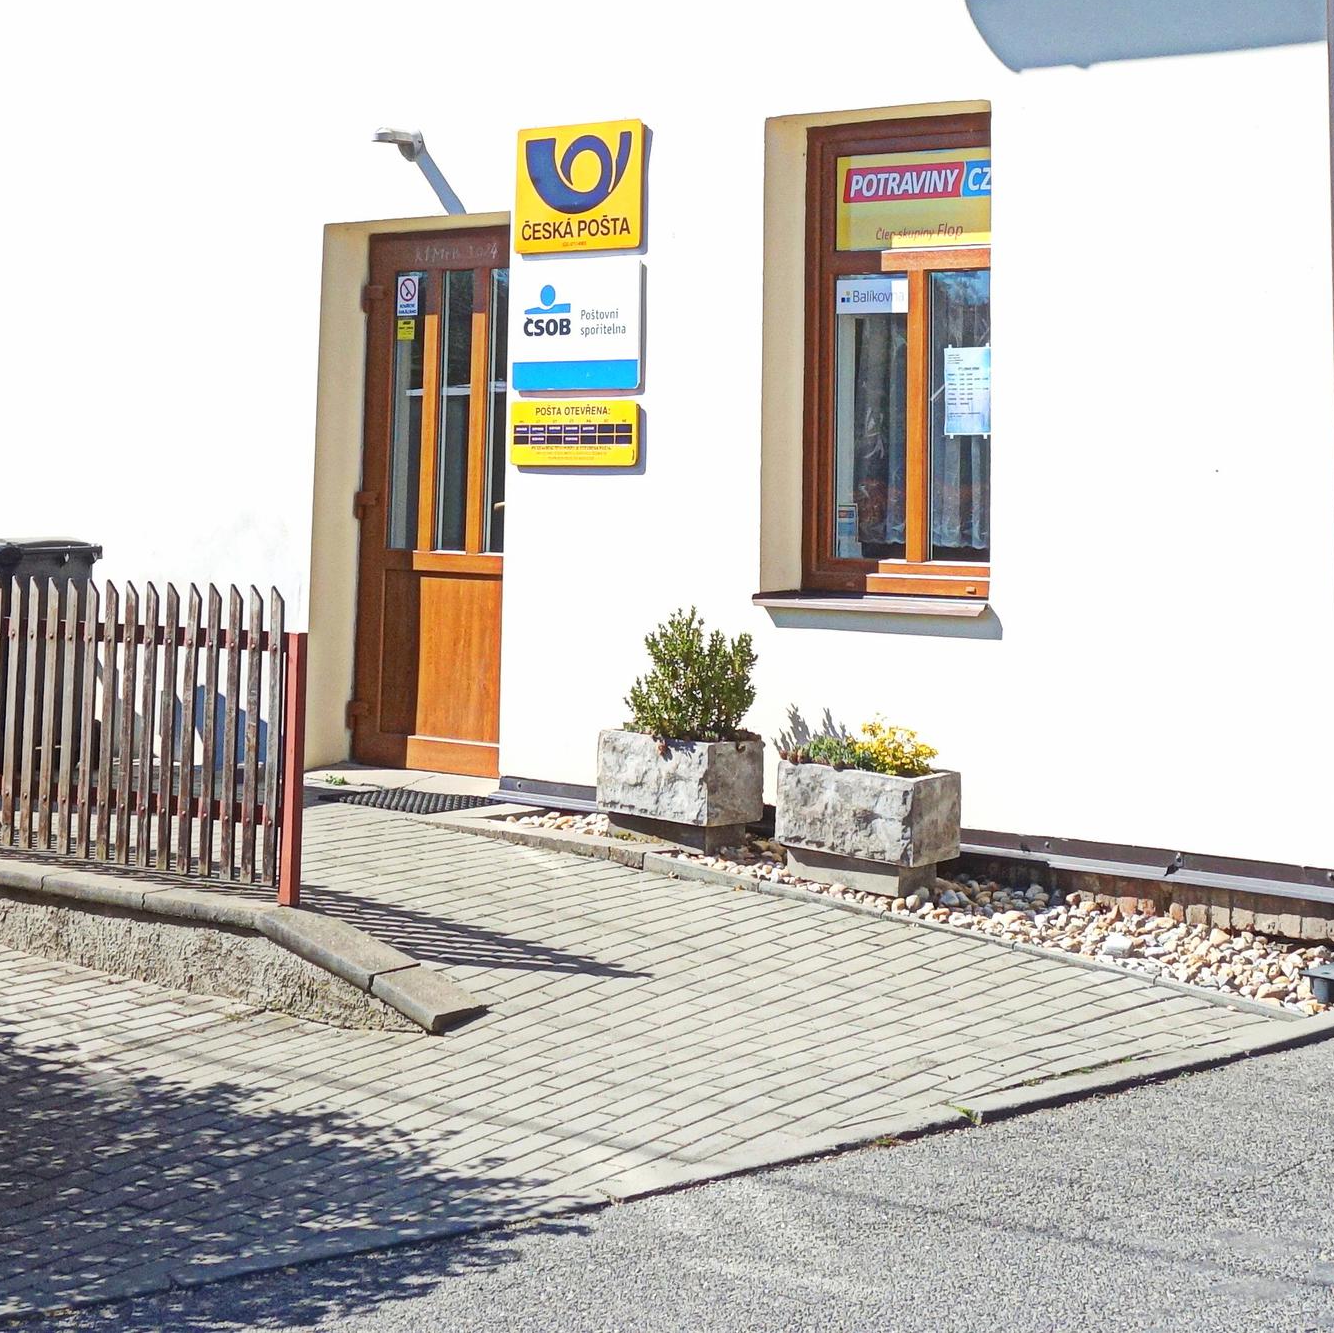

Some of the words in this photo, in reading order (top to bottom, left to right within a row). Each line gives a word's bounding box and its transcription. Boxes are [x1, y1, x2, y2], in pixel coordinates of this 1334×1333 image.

[849, 168, 960, 199] POTRAVINY
[521, 218, 574, 241] ČESKÁ
[577, 215, 631, 237] POŠTA
[937, 222, 964, 241] Flop
[580, 308, 619, 321] Poštovní
[523, 316, 572, 337] ČSOB
[580, 323, 627, 337] spořitelna
[535, 405, 562, 416] POŠTA
